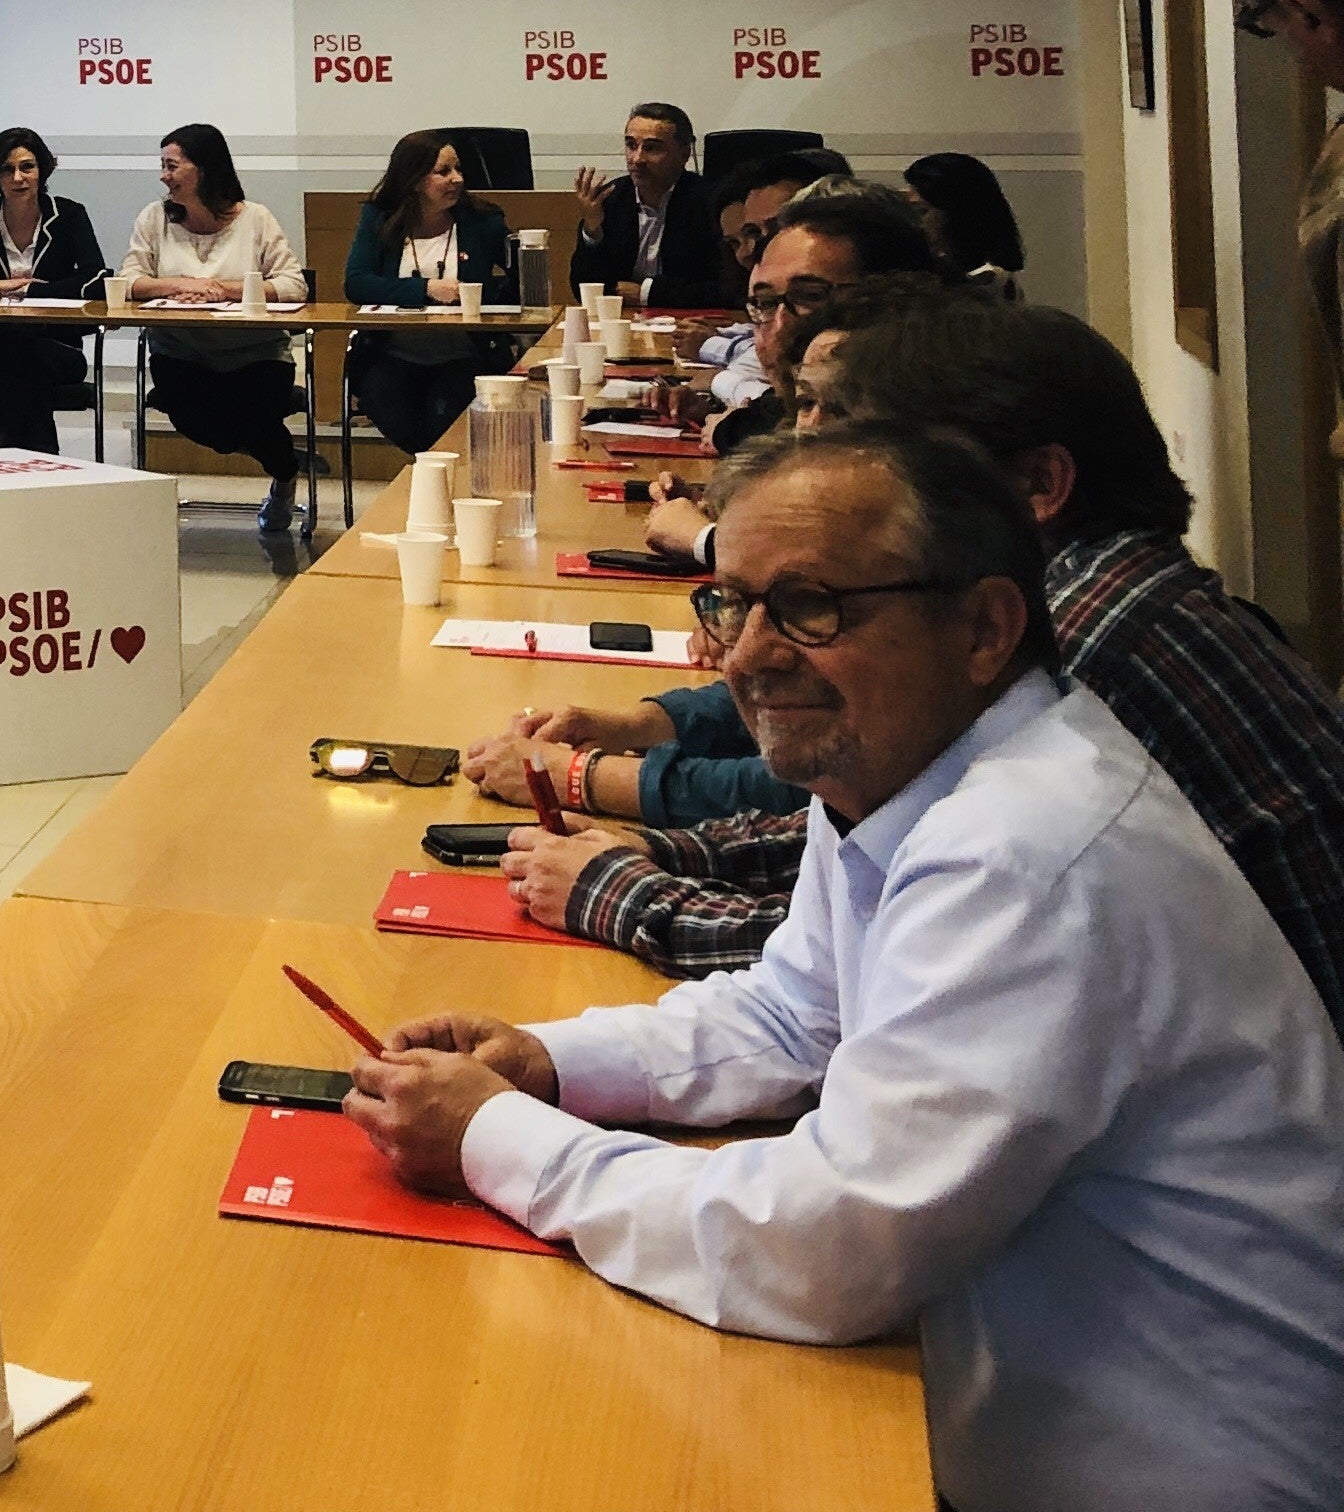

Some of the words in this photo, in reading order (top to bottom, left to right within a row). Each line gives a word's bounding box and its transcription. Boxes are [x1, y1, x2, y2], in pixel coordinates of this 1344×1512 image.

[313, 34, 362, 53] PSIB
[524, 30, 576, 50] PSIB
[733, 27, 787, 48] PSIB
[969, 23, 1028, 43] PSIB
[78, 37, 124, 55] PSIB
[79, 58, 153, 85] PSOE
[314, 55, 394, 84] PSOE
[525, 52, 608, 81] PSOE
[734, 49, 822, 80] PSOE
[971, 47, 1065, 78] PSOE
